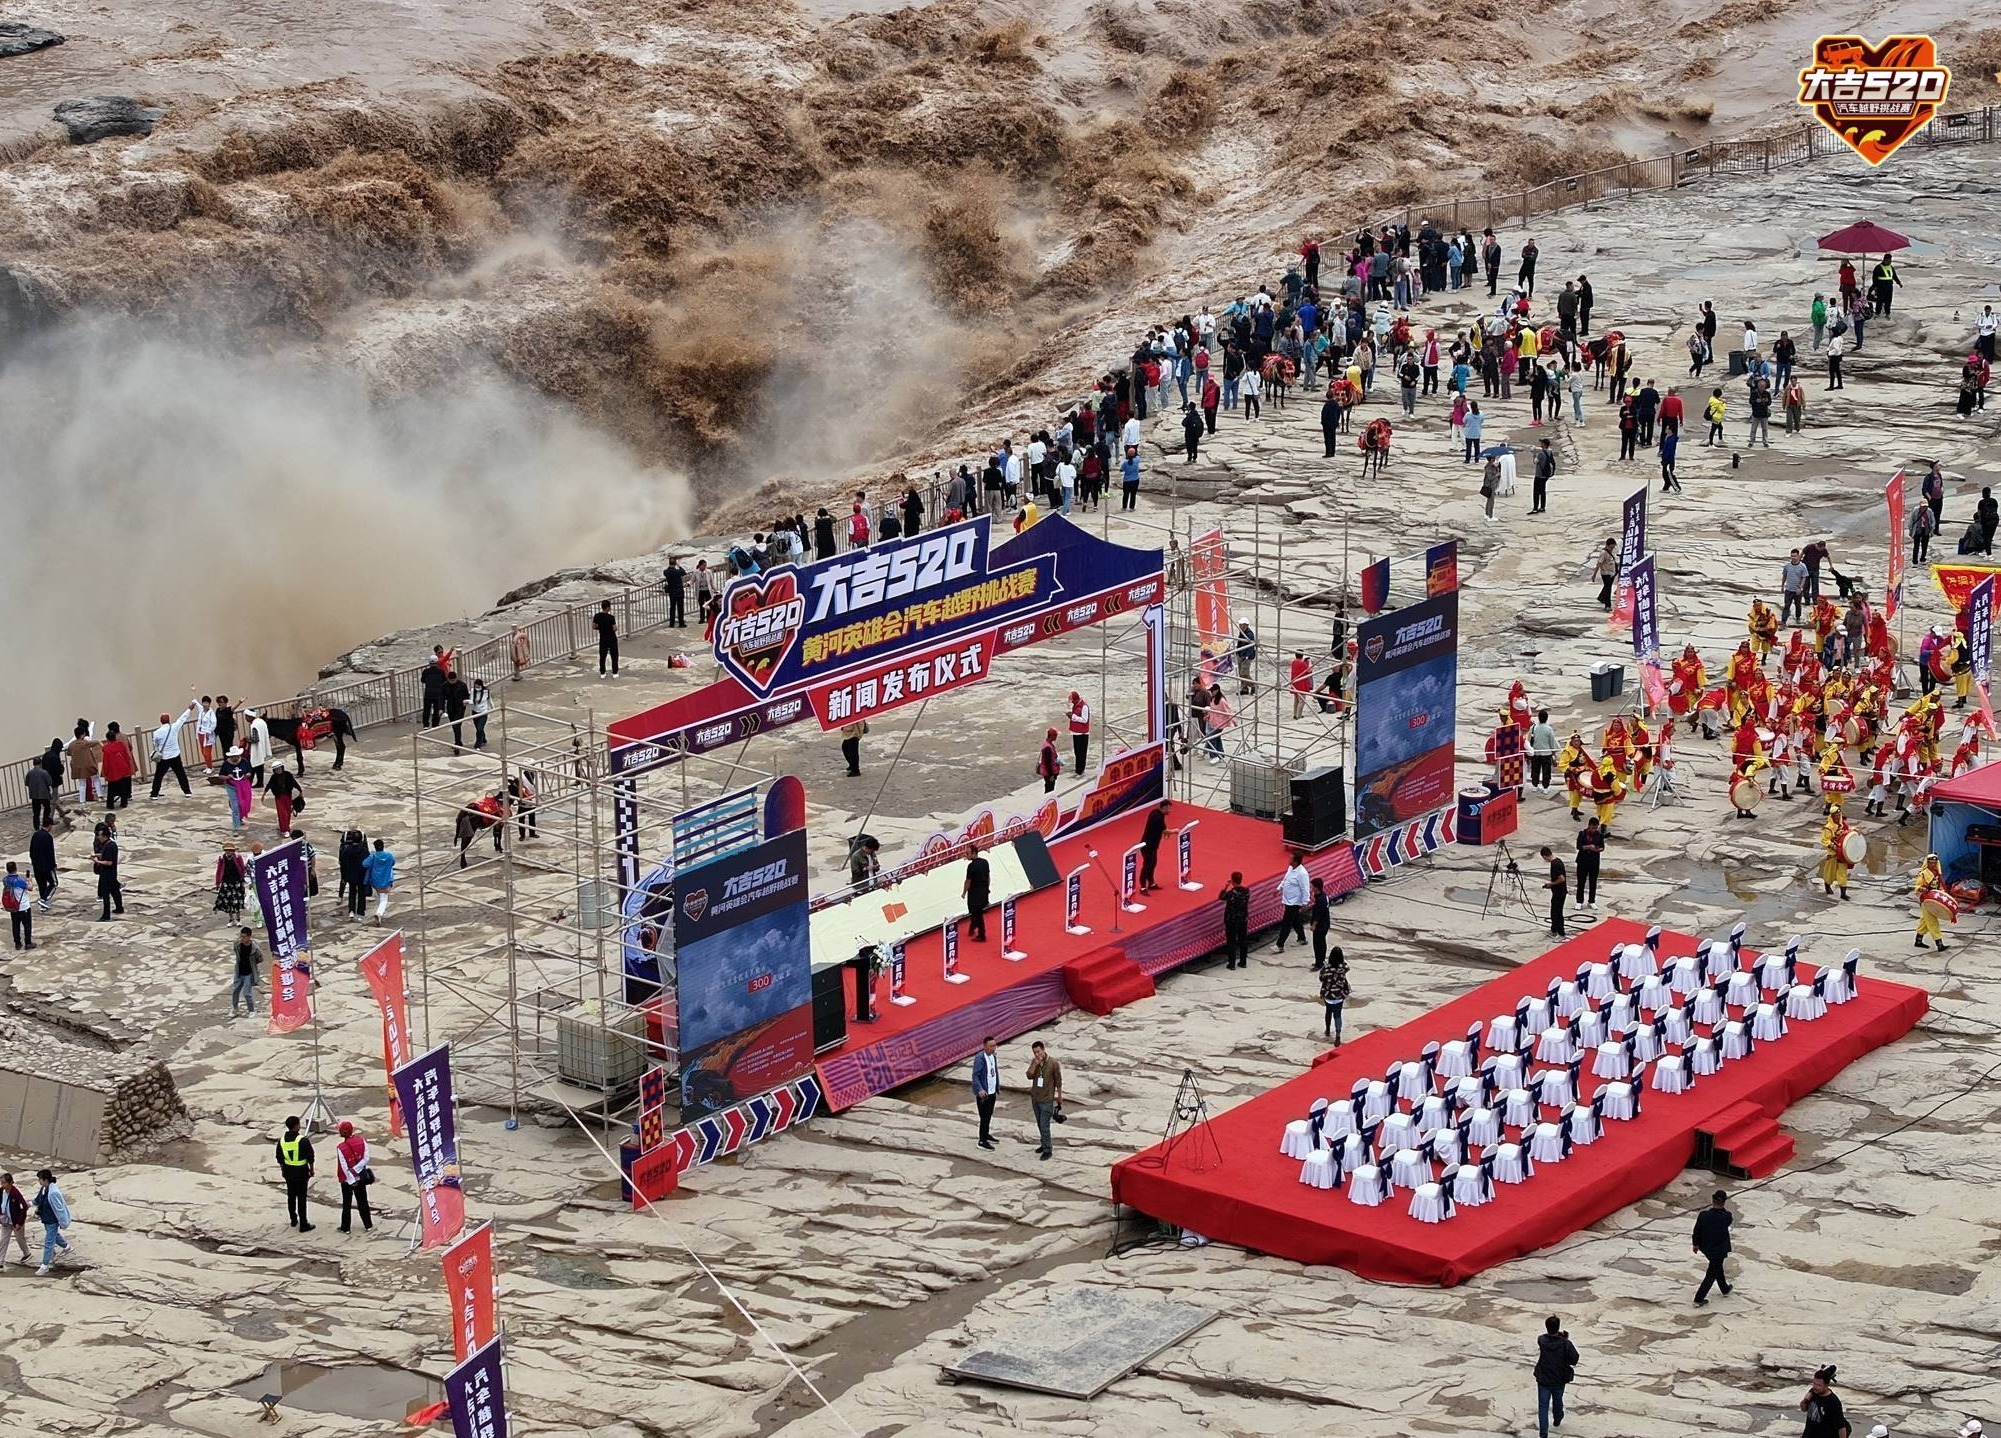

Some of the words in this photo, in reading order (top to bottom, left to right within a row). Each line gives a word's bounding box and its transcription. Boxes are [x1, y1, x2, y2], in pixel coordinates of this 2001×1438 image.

[806, 528, 979, 625] 大吉520
[1128, 582, 1158, 600] 大吉520
[802, 567, 1038, 666] 黄河英雄会汽车越野挑战赛
[1066, 603, 1098, 621] 大吉520
[724, 601, 800, 647] 大吉520
[1004, 623, 1036, 642] 大吉520
[1394, 615, 1443, 647] 大吉520
[828, 643, 983, 721] 新闻发布仪式
[767, 699, 801, 721] 大吉520
[1411, 715, 1425, 727] 300
[696, 722, 732, 742] 大吉520
[623, 747, 659, 767] 大吉520
[721, 858, 788, 900] 大吉520
[752, 976, 770, 990] 300
